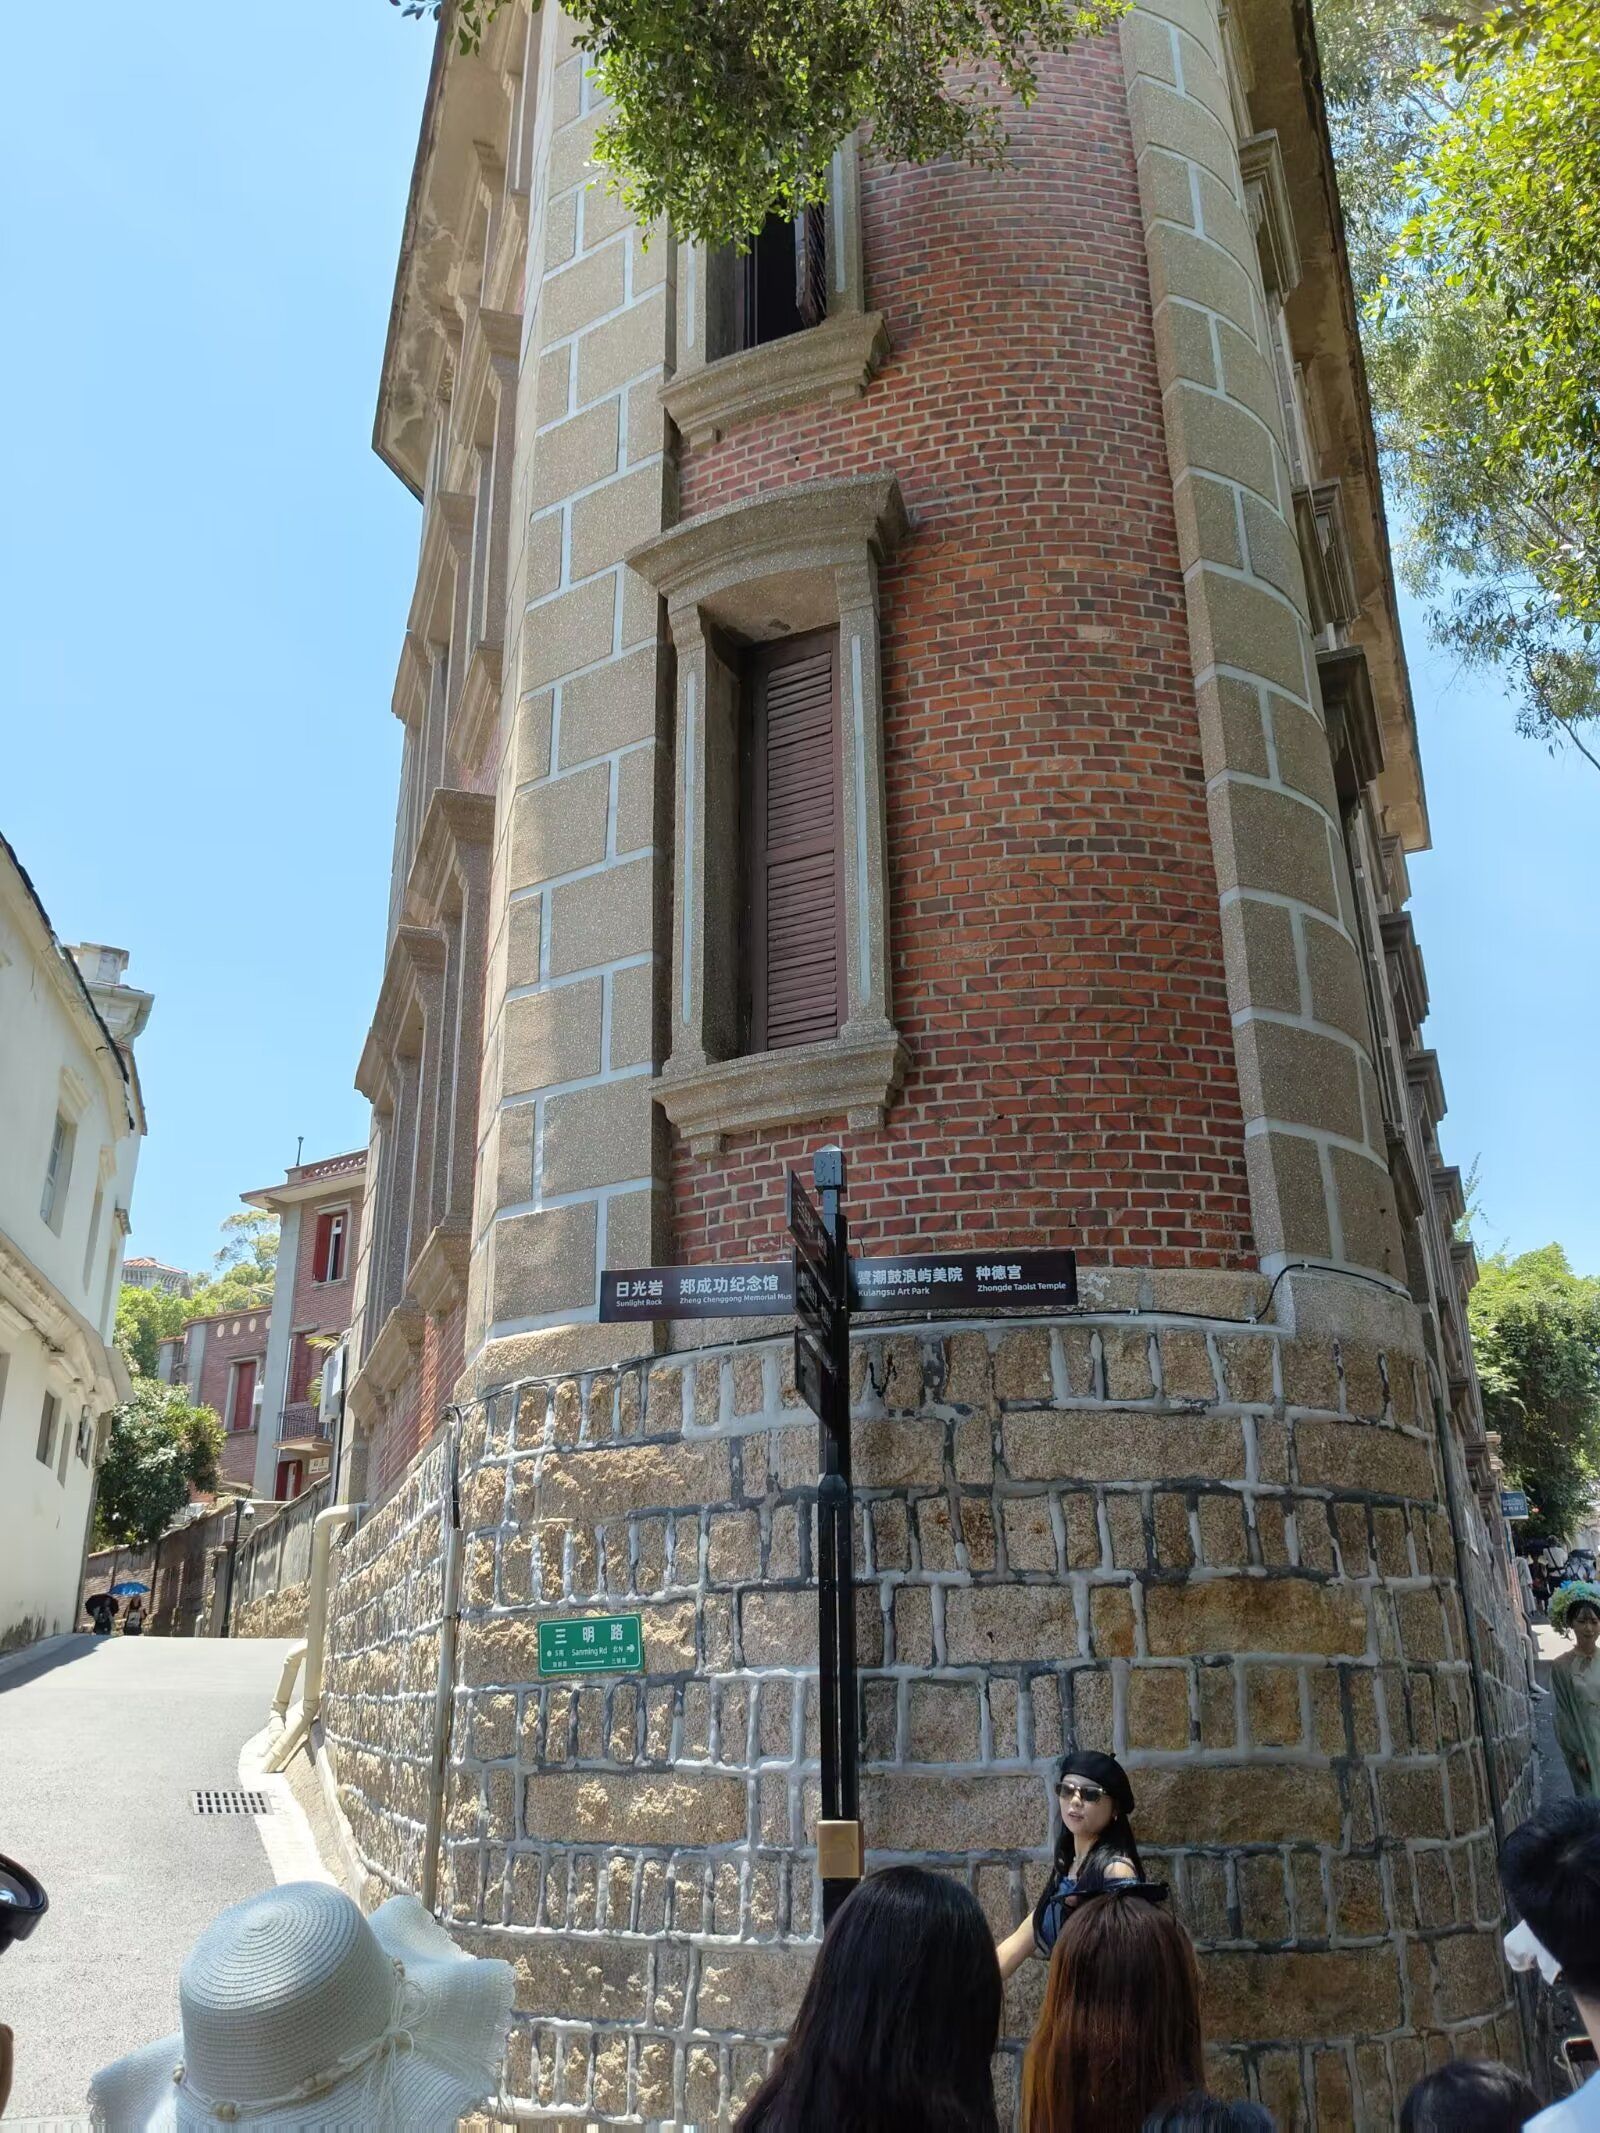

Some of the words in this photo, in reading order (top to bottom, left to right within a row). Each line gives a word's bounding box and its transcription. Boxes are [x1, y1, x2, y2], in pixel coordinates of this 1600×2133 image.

[857, 1267, 963, 1285] 鹭潮鼓浪屿美院
[976, 1264, 1022, 1281] 种德宫
[616, 1280, 663, 1298] 日光岩
[679, 1274, 779, 1295] 郑成功纪念馆
[858, 1288, 896, 1298] Kulangsu
[897, 1287, 910, 1296] Art
[912, 1286, 930, 1295] Park
[977, 1283, 1012, 1293] Zhongde
[1014, 1282, 1036, 1291] Taoist
[1038, 1281, 1067, 1291] Temple
[616, 1299, 645, 1308] Sunlight
[646, 1298, 662, 1306] Rock
[679, 1297, 702, 1305] Zheng
[703, 1295, 742, 1305] Chenggong
[743, 1293, 776, 1302] Memorial
[554, 1623, 623, 1644] 三明路
[571, 1647, 598, 1657] Sanming
[599, 1646, 608, 1655] Rd
